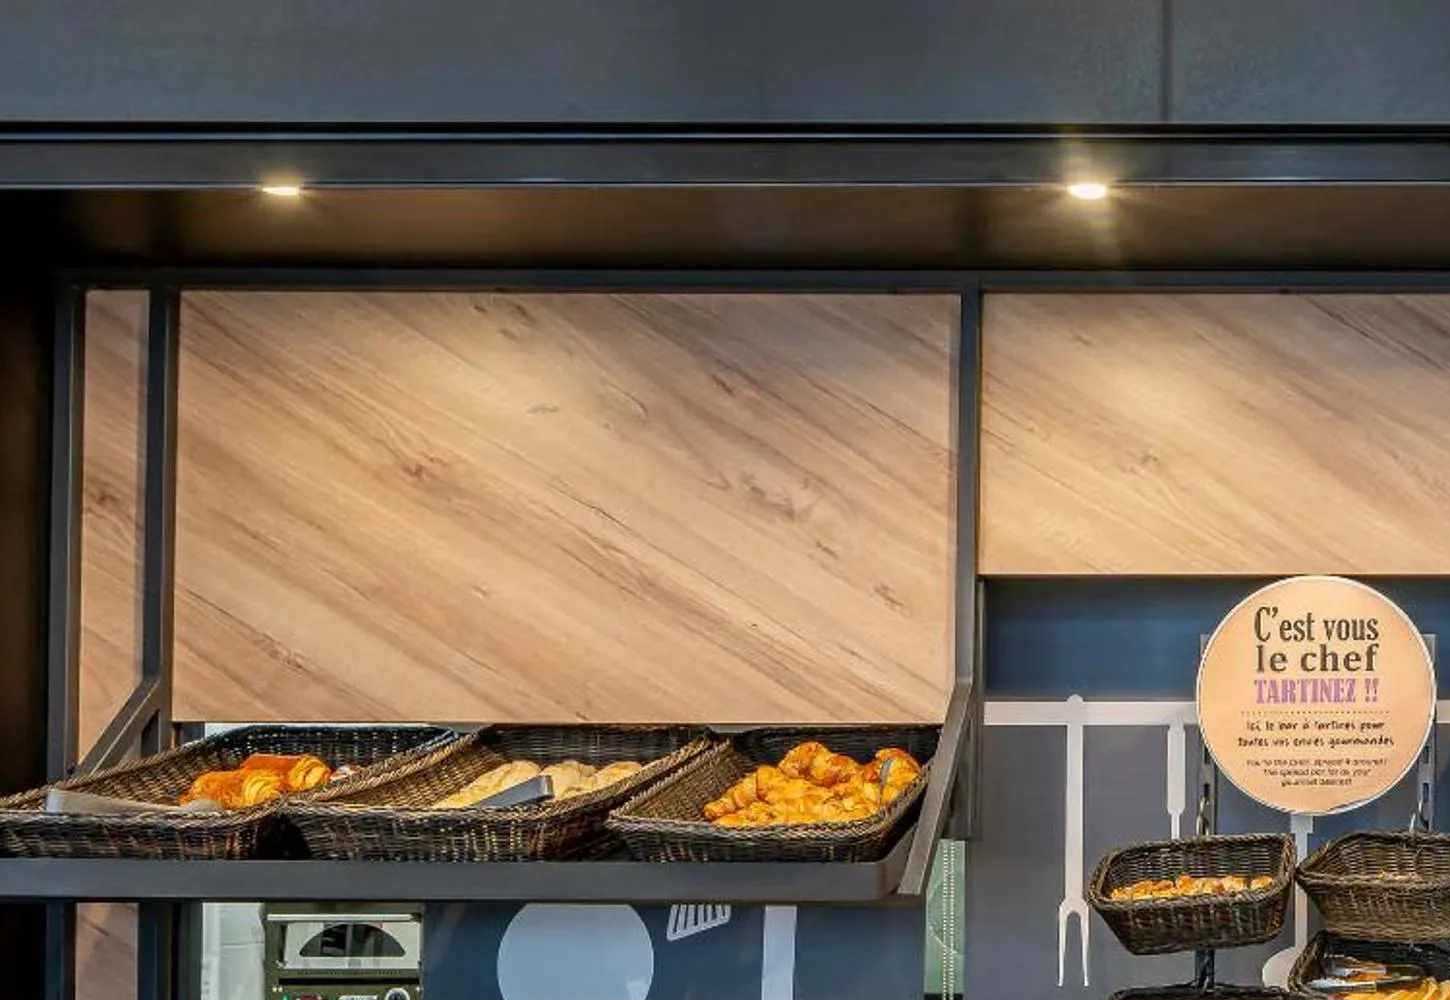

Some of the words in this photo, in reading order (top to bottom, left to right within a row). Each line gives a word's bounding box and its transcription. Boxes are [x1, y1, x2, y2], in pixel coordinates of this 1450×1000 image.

[1254, 606, 1315, 642] C'est
[1322, 618, 1379, 641] vous
[1256, 644, 1288, 673] le
[1300, 643, 1379, 672] chef
[1254, 678, 1356, 704] TARTINEZ
